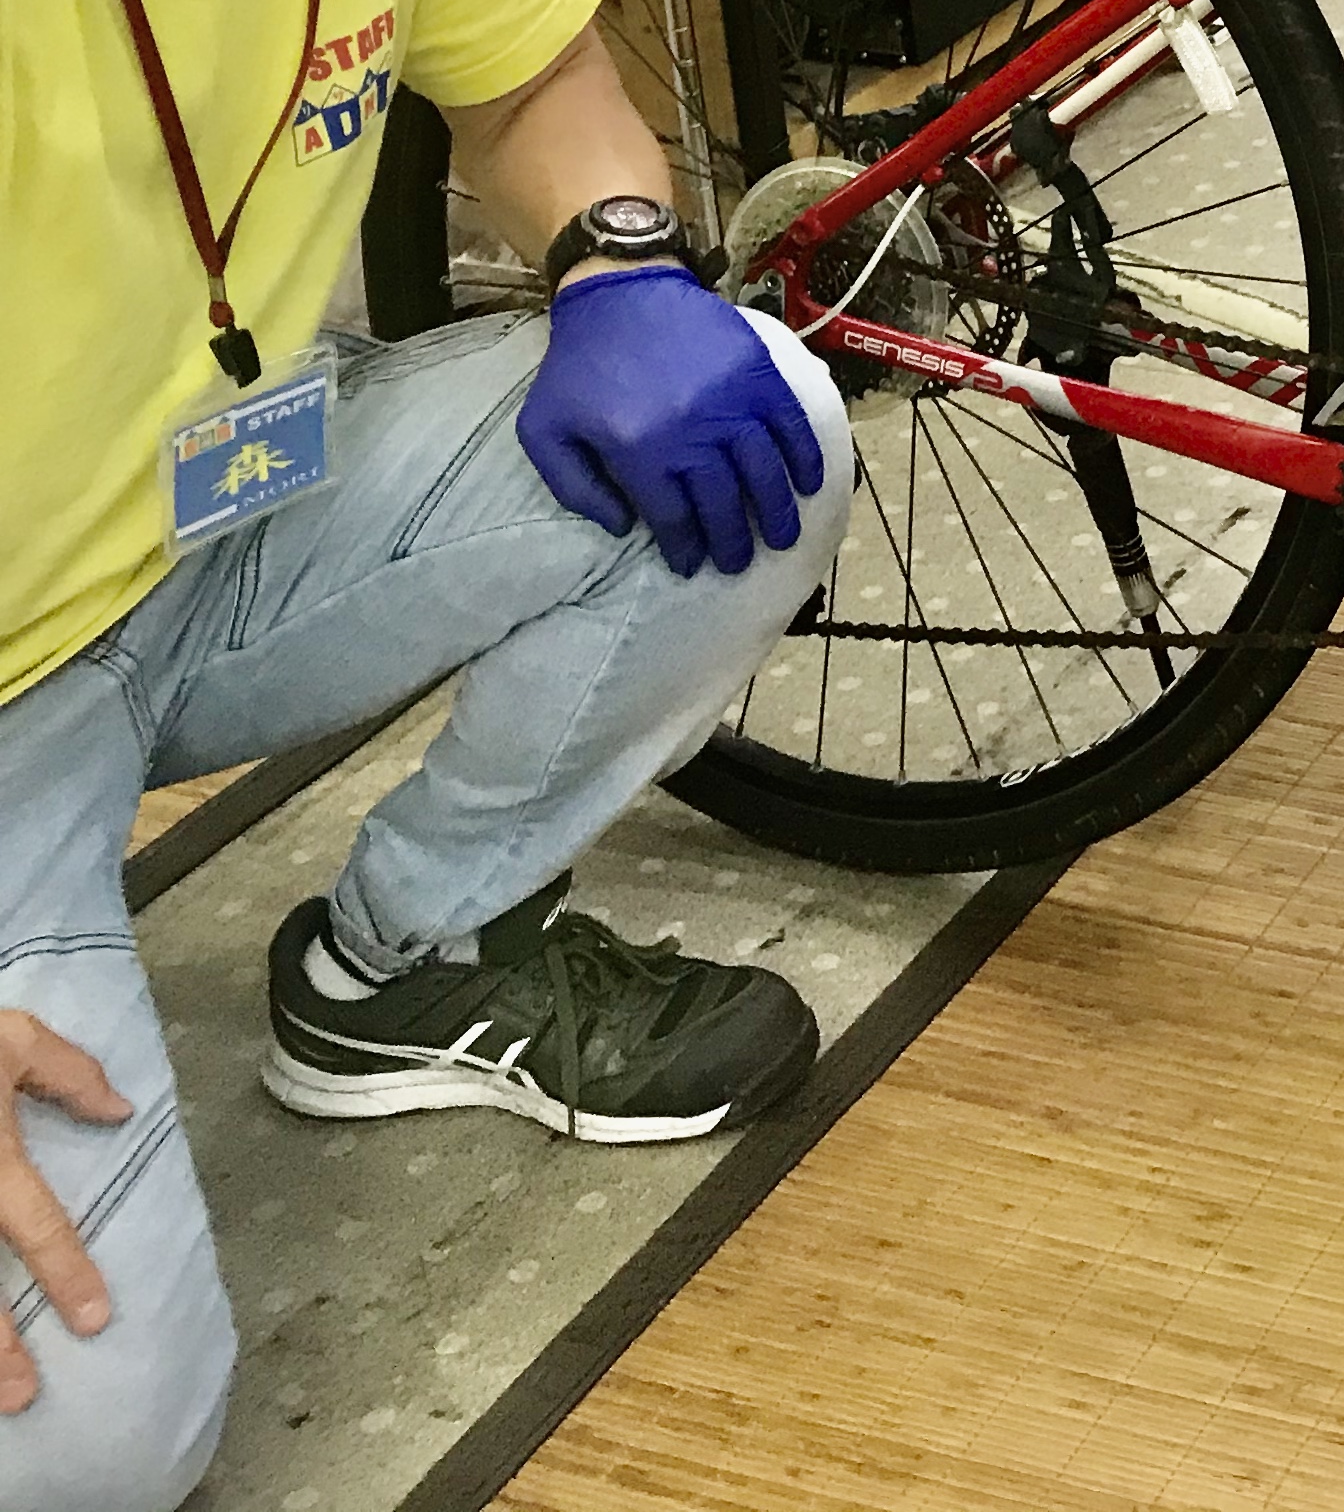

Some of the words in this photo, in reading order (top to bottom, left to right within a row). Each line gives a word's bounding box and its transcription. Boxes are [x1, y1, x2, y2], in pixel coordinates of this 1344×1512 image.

[843, 329, 964, 380] GENESIS
[246, 392, 319, 432] STAFF
[211, 439, 294, 500] 森
